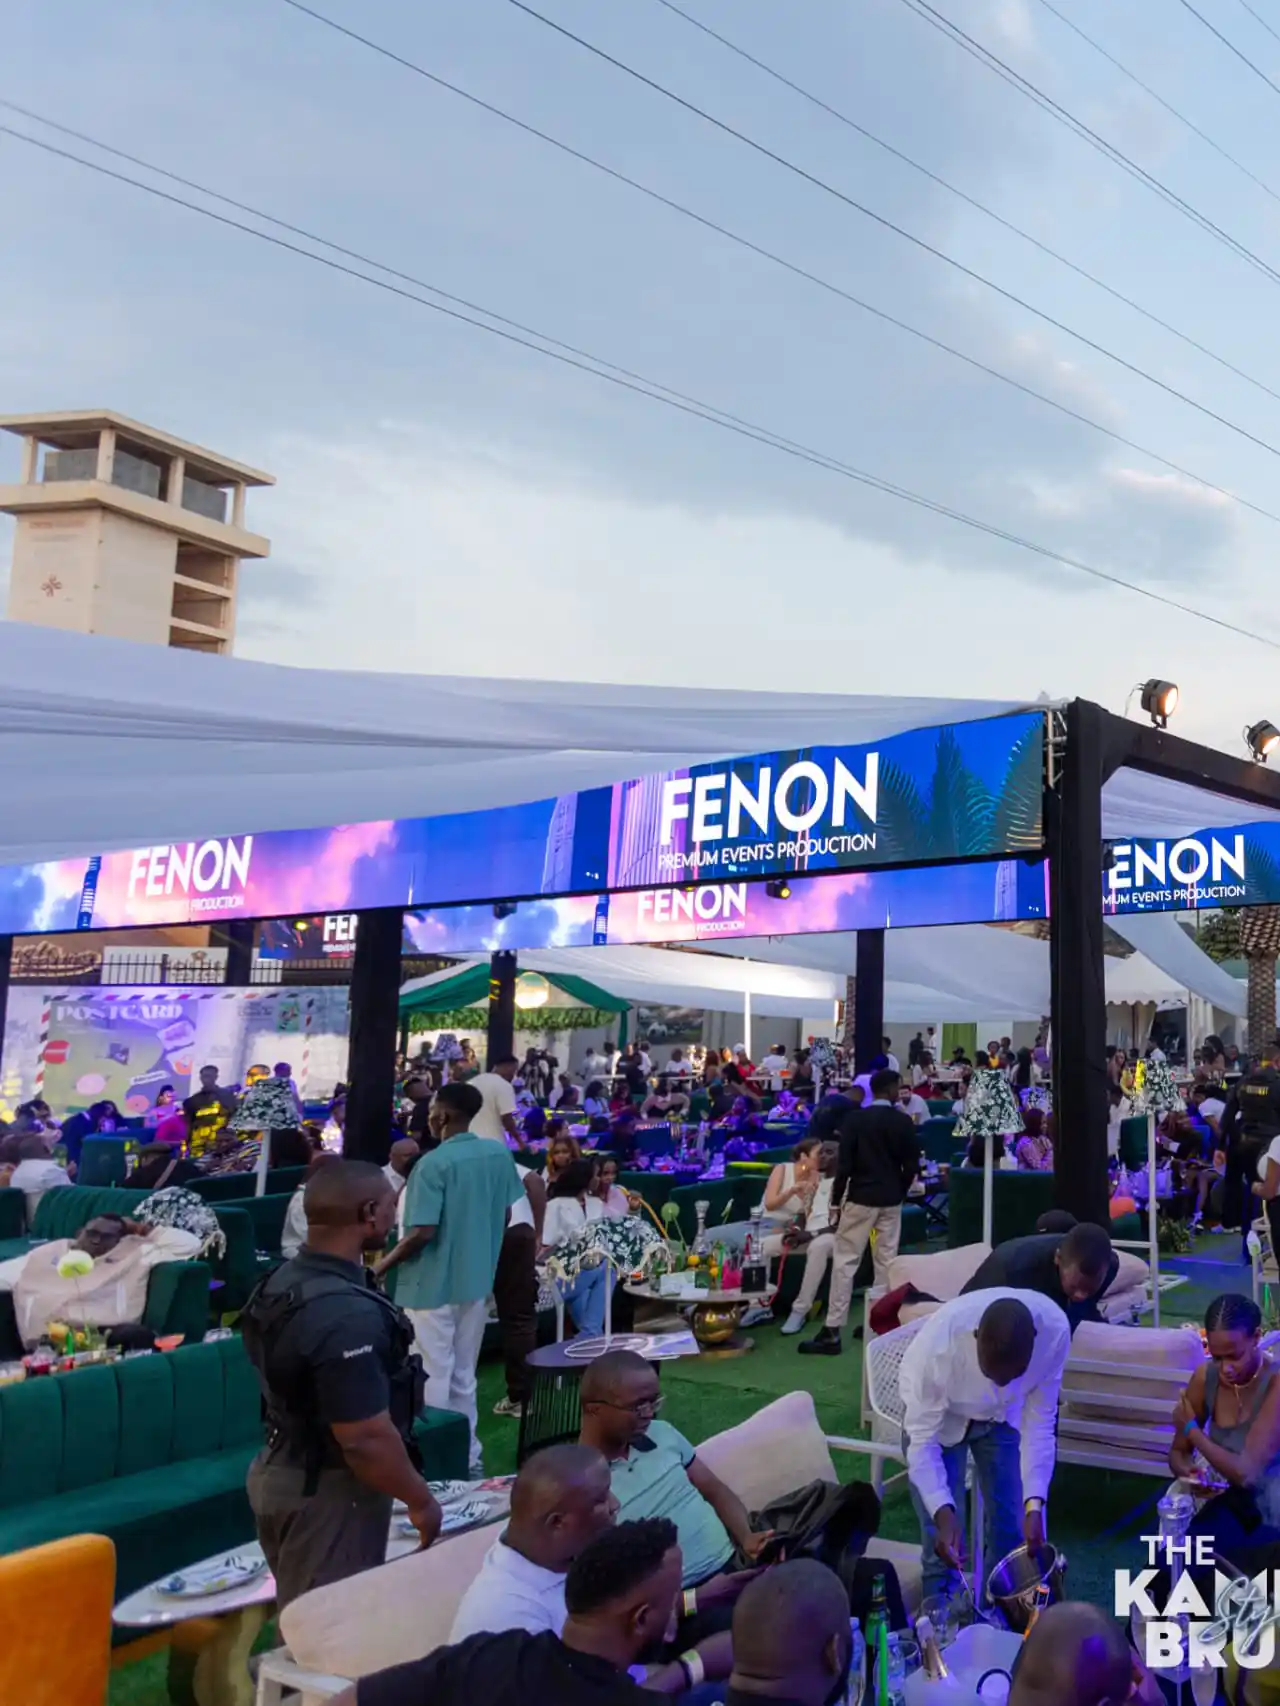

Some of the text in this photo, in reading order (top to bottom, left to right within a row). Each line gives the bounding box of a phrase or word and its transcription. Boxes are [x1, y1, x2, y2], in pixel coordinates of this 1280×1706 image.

[660, 752, 879, 846] FENON
[127, 835, 253, 898] FENON
[658, 832, 877, 871] PREMIUM EVENTS PRODUCTION
[637, 883, 748, 923] FENON
[1132, 889, 1172, 904] EVENTS
[1173, 885, 1246, 901] PRODUCTION
[57, 1003, 183, 1021] POSTCARD
[343, 1344, 374, 1359] Security
